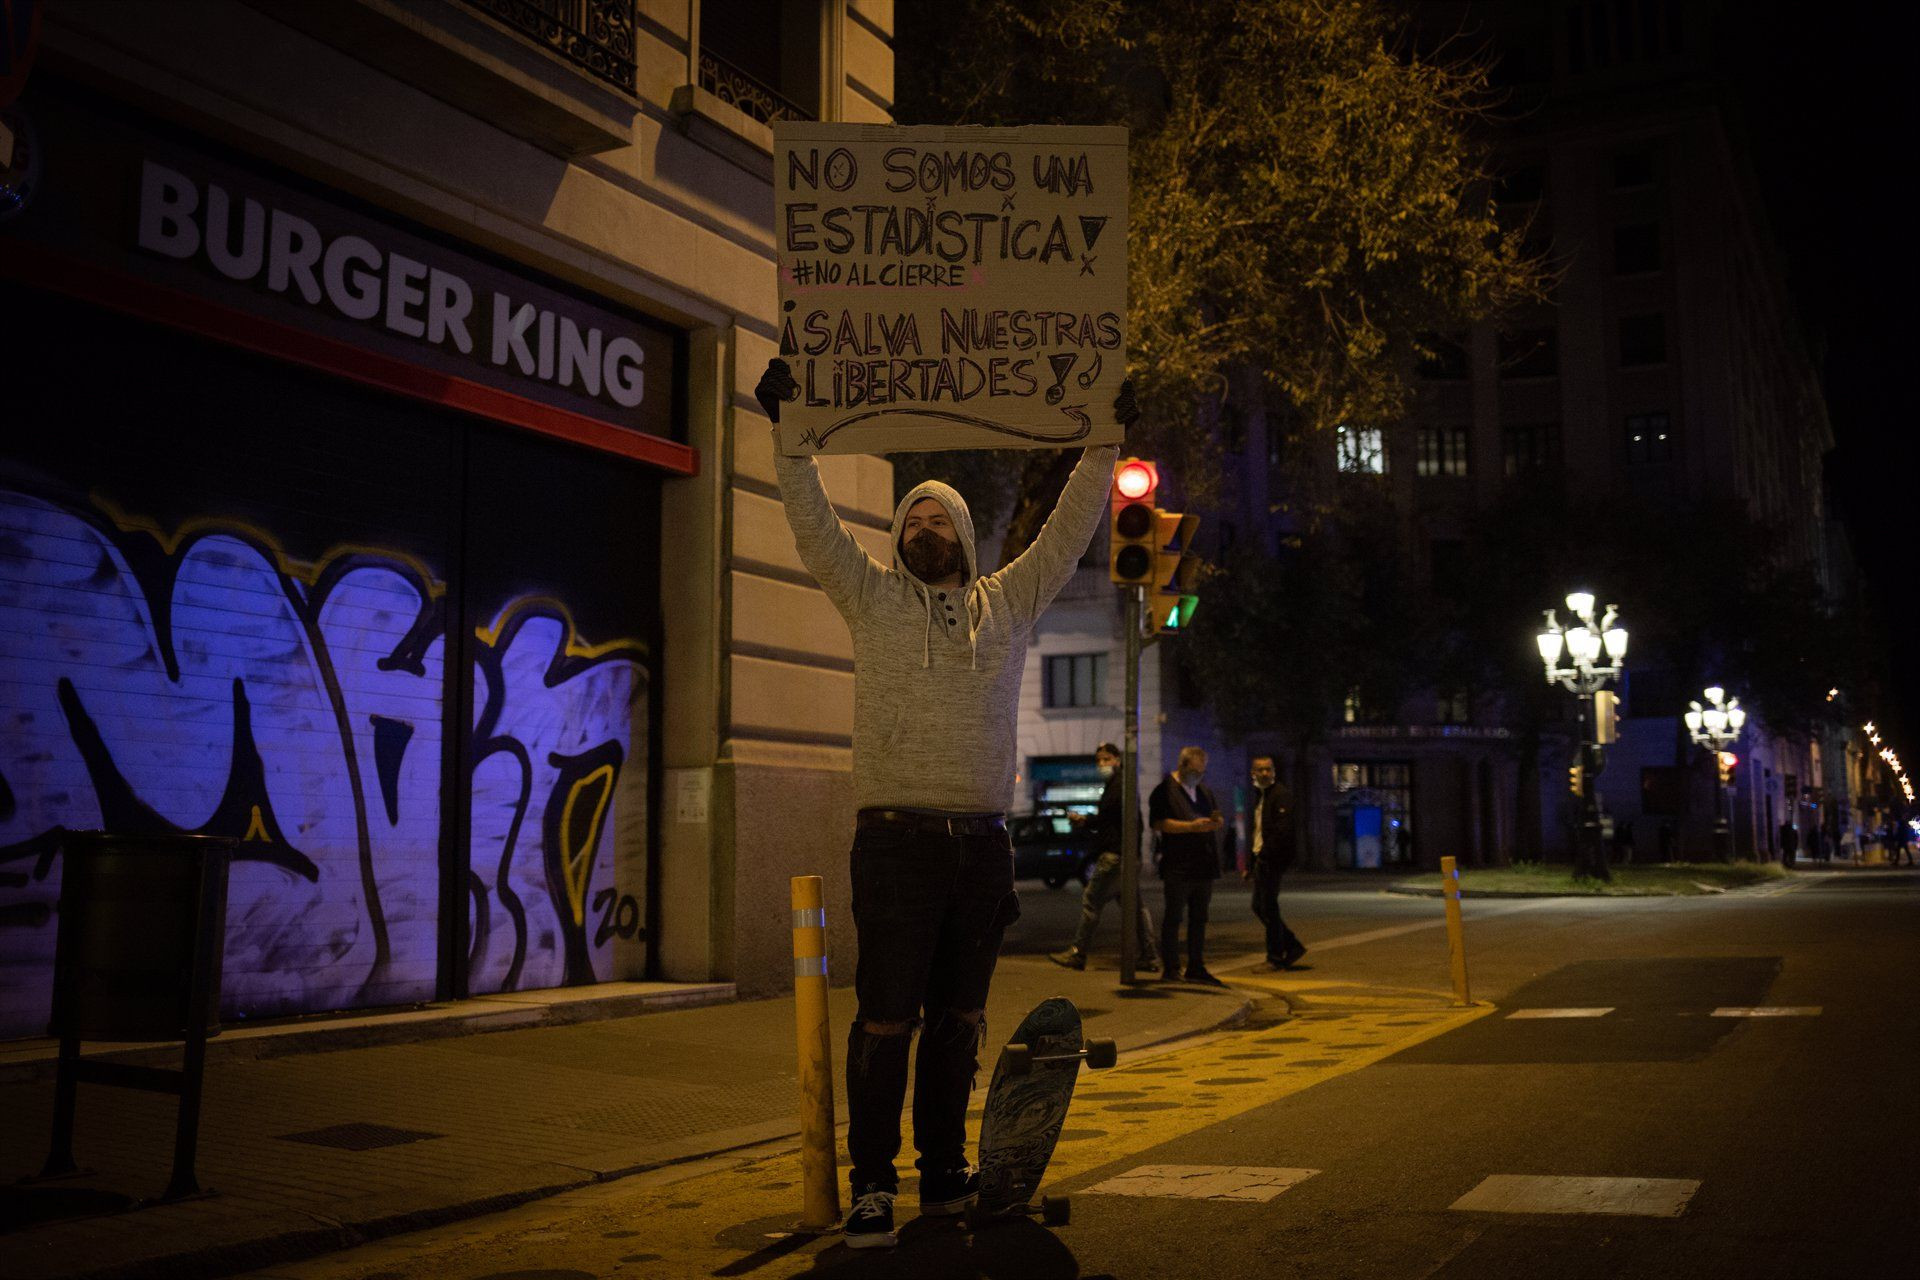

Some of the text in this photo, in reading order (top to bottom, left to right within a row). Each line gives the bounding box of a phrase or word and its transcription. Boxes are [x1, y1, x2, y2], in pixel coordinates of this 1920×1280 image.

[788, 147, 1094, 197] NO SOMOS UNA
[137, 158, 645, 408] BURGER KING
[940, 307, 1122, 355] NUESTRAS
